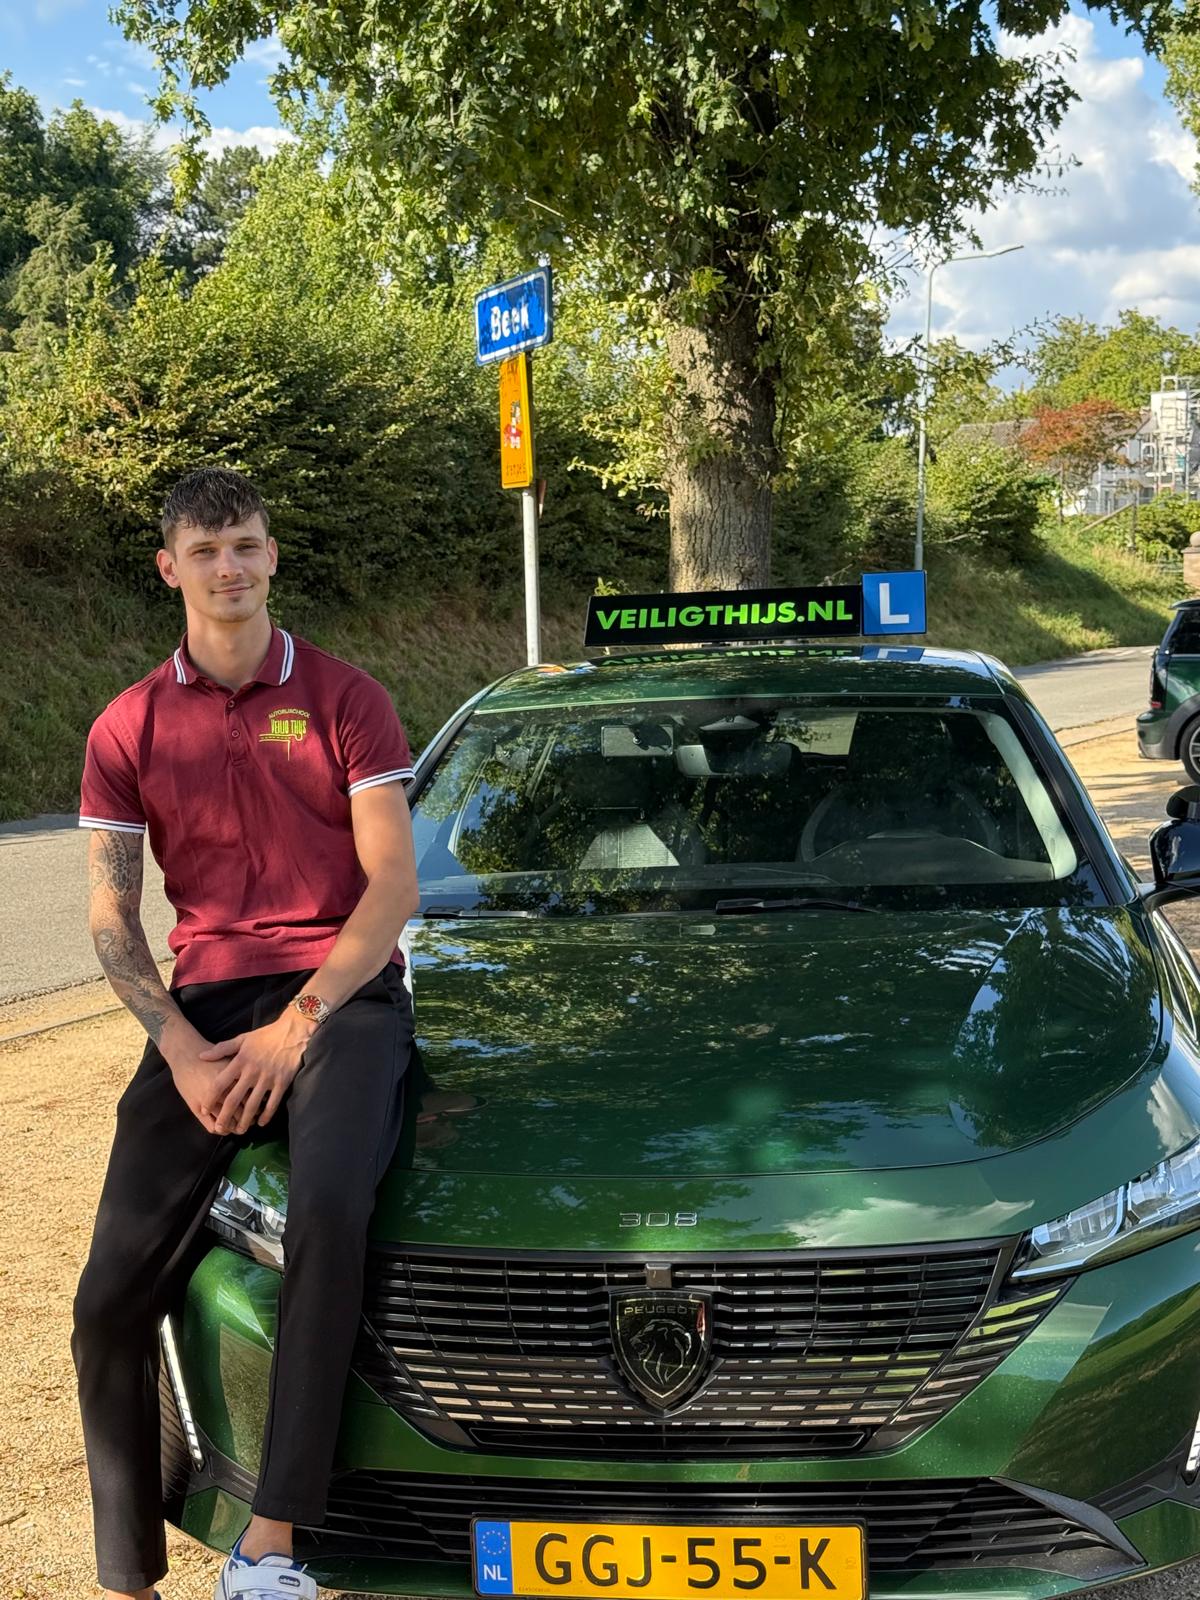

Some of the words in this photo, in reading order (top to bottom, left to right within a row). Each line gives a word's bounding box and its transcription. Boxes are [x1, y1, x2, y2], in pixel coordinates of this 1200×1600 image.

[491, 303, 530, 342] Beek
[596, 600, 852, 630] VEILIGTHIJS.NL
[879, 582, 910, 625] L
[619, 1212, 698, 1227] 308
[624, 1305, 698, 1315] PEUGEOT
[483, 1564, 508, 1581] NL
[535, 1532, 837, 1590] GGJ-55-K
